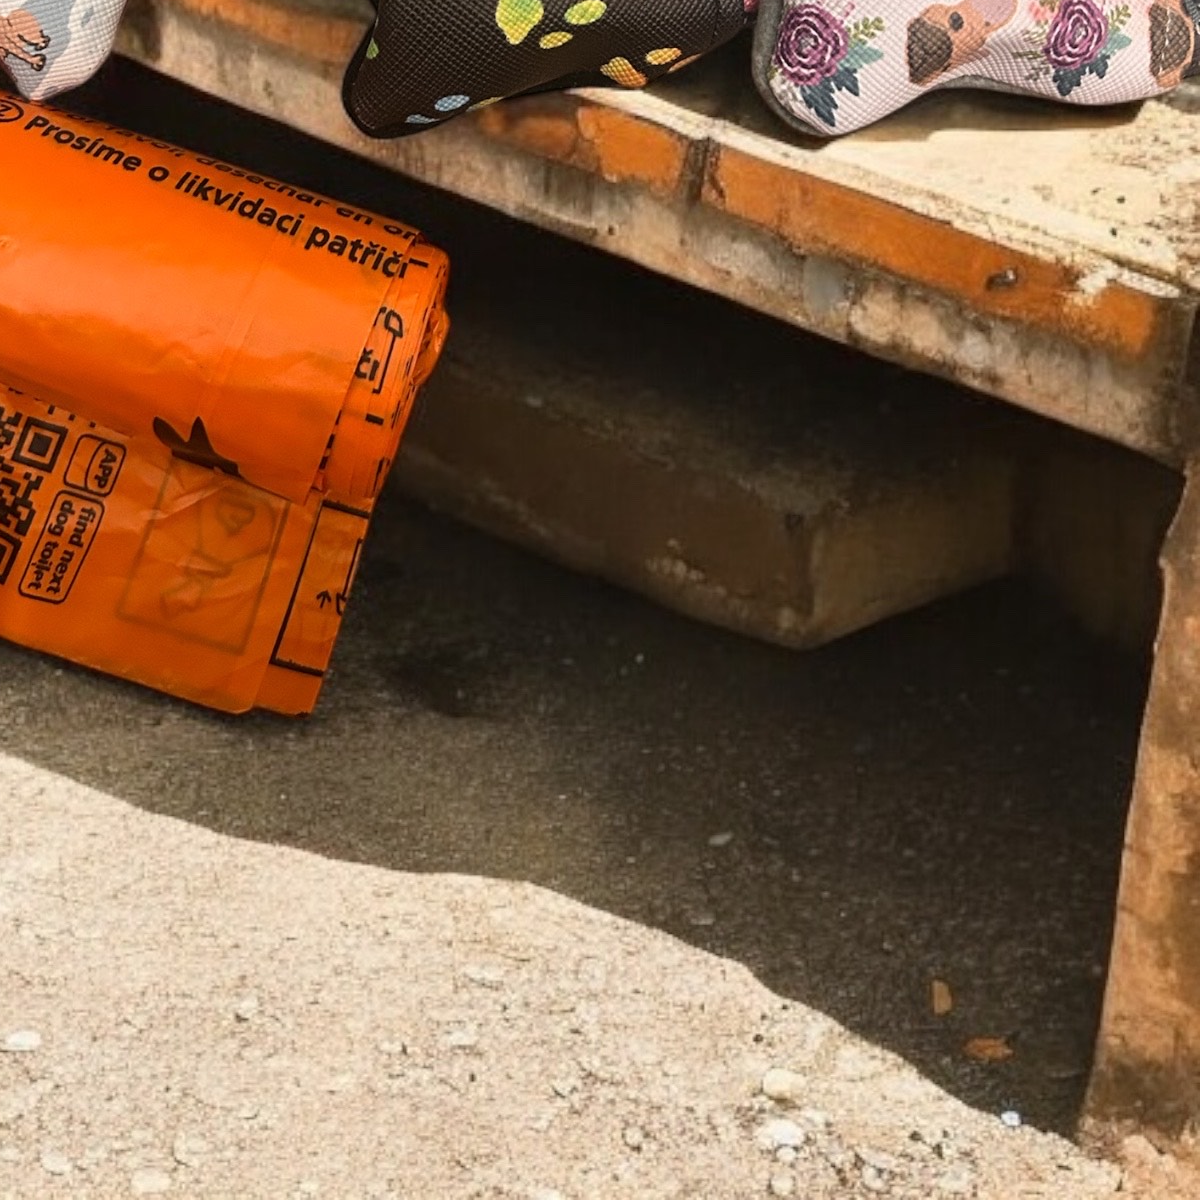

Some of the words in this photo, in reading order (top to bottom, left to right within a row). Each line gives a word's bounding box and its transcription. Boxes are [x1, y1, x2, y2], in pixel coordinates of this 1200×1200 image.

[24, 115, 142, 172] Prosíme
[148, 166, 170, 182] o
[174, 171, 305, 237] likvidaci
[94, 447, 118, 490] APP
[47, 499, 76, 537] dog
[67, 506, 97, 548] find
[46, 549, 76, 595] next
